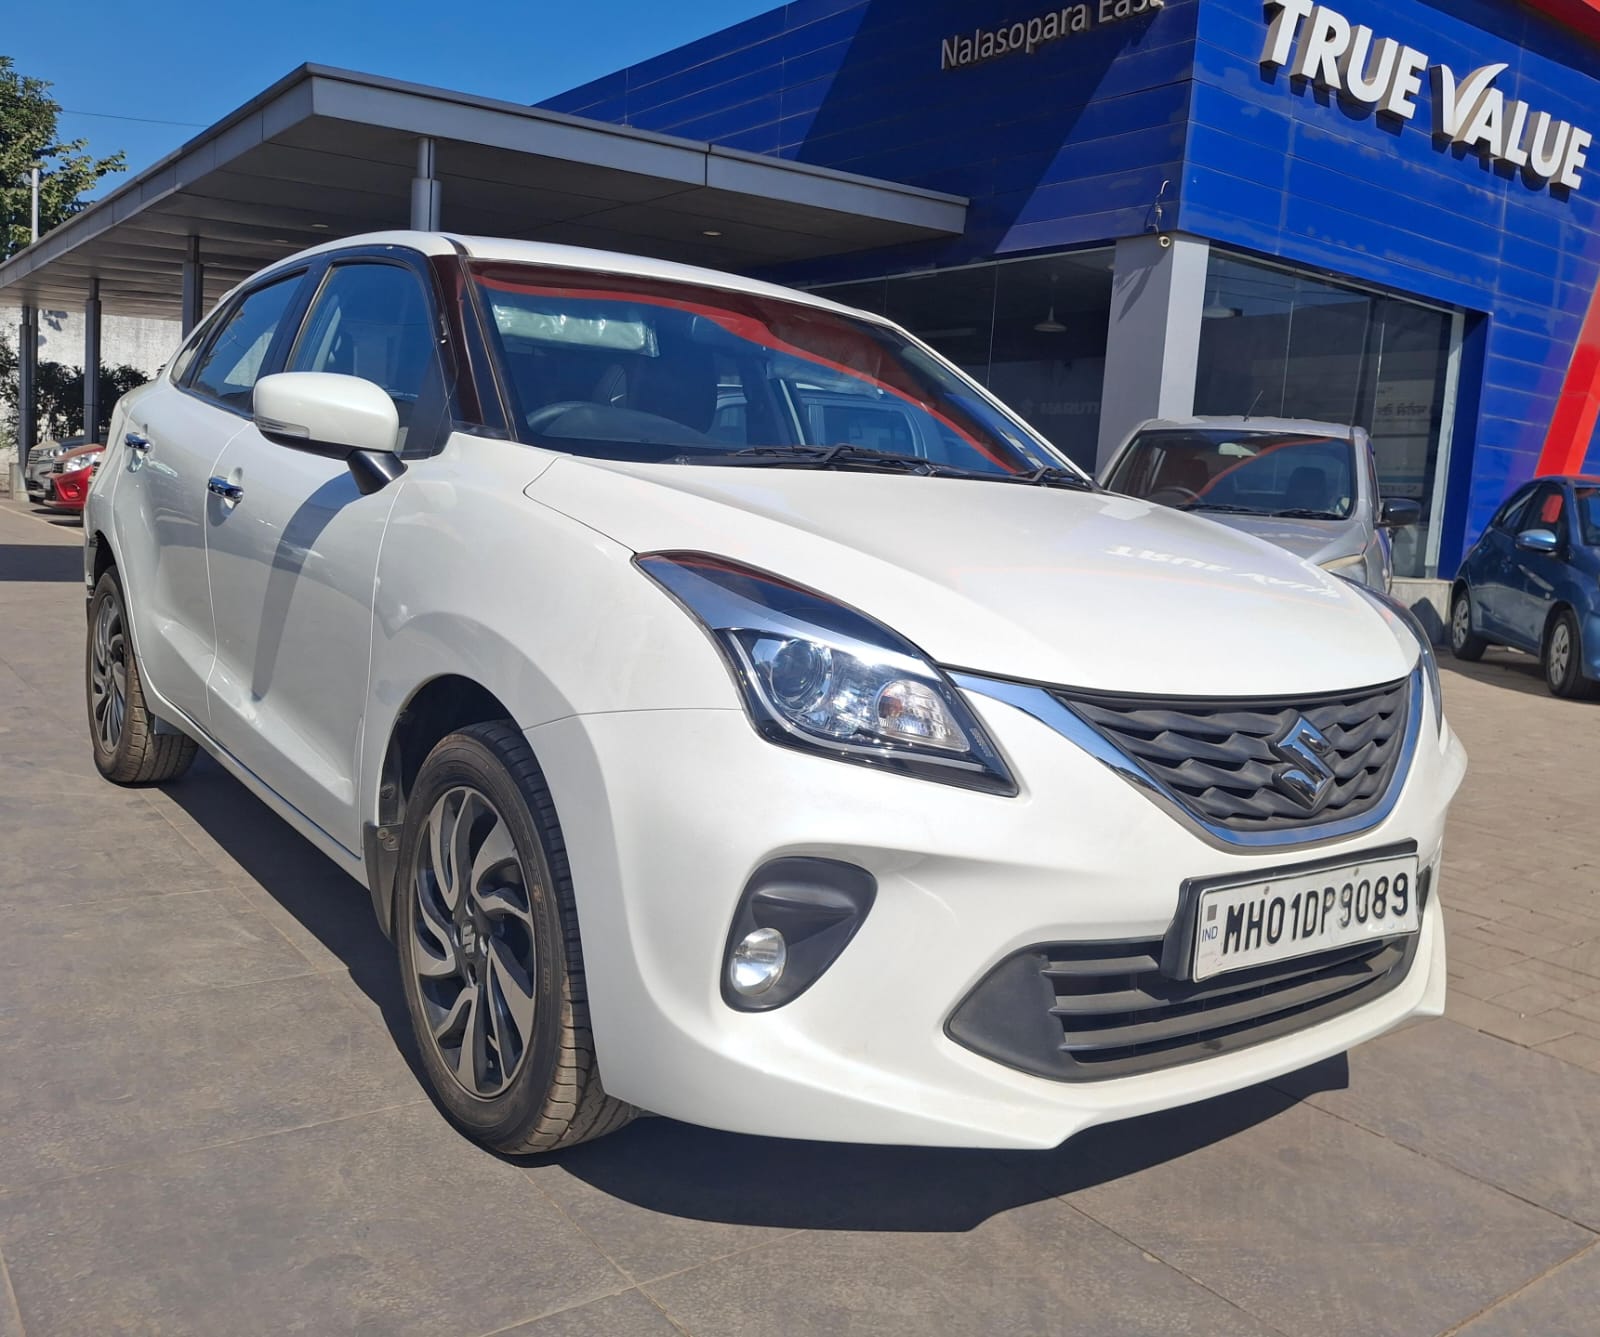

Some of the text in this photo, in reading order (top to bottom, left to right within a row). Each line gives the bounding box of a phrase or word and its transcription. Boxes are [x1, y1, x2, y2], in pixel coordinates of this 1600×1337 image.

[941, 0, 1164, 70] Nalasopara Eas
[1261, 0, 1592, 190] TRUE VALUE
[1201, 925, 1218, 943] IND
[1223, 872, 1409, 955] MH01DP9089
